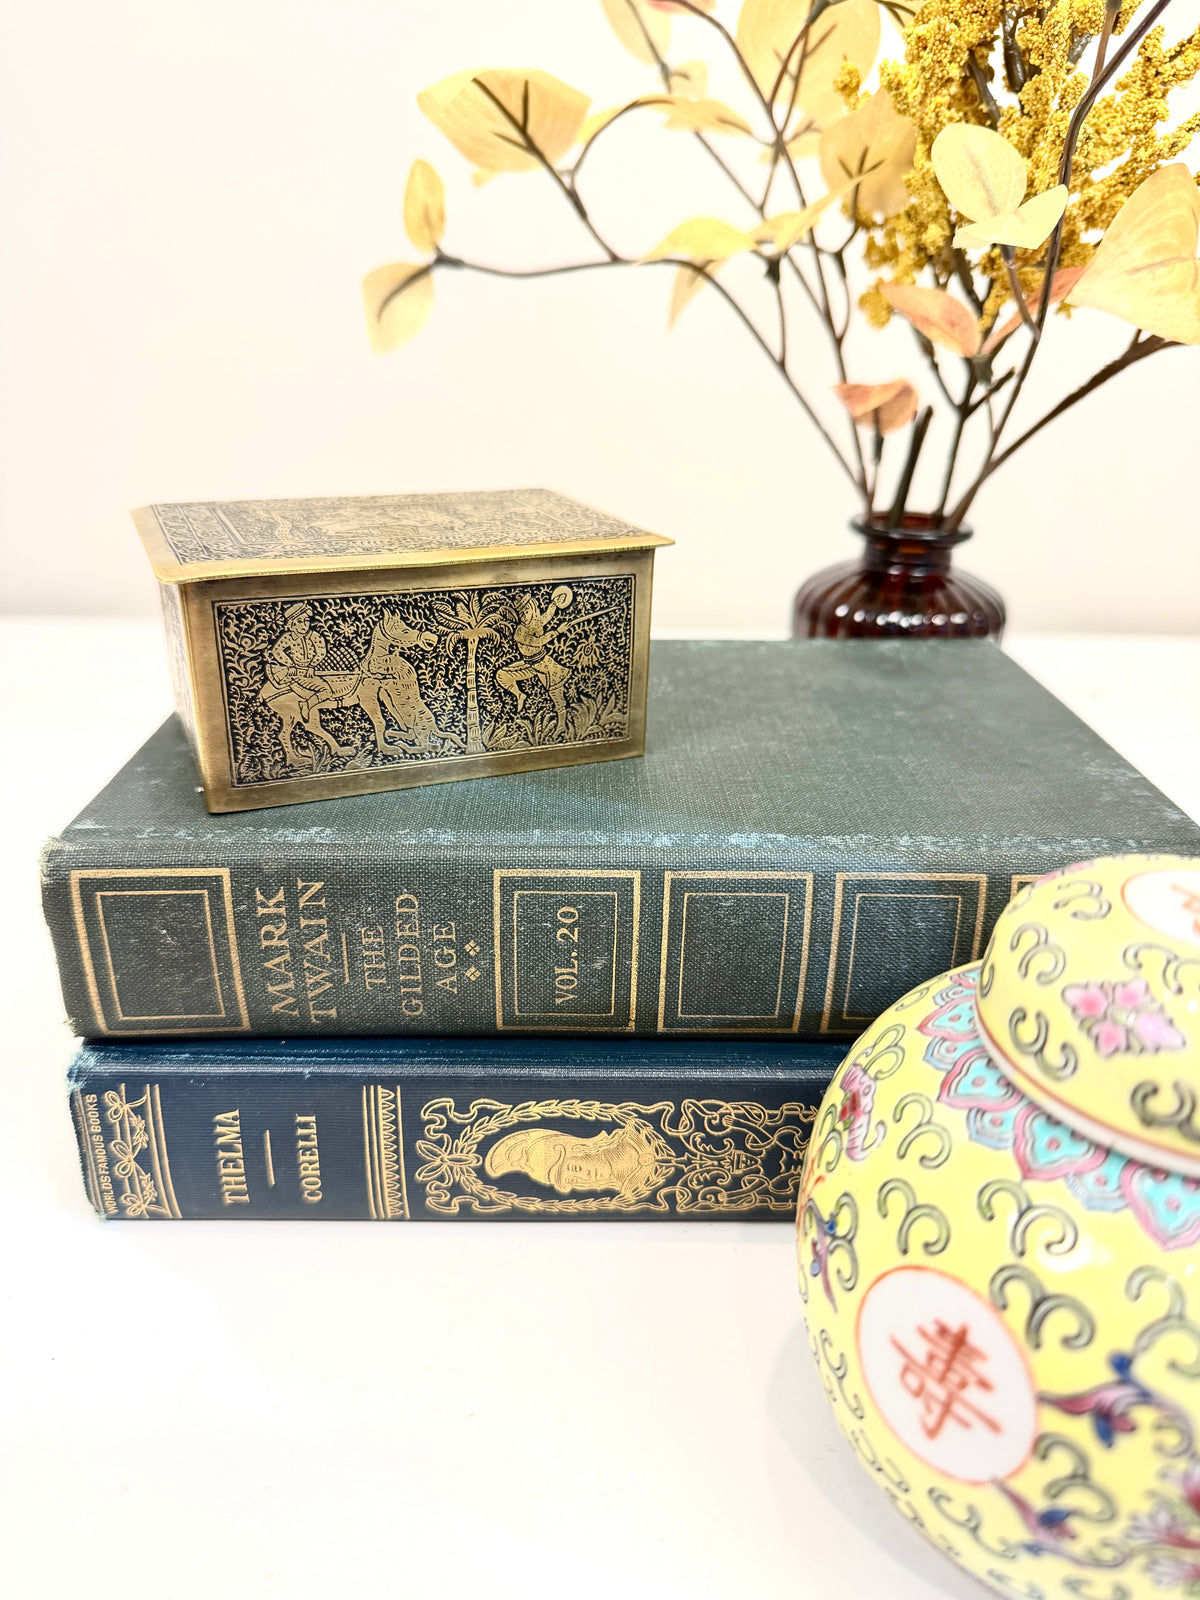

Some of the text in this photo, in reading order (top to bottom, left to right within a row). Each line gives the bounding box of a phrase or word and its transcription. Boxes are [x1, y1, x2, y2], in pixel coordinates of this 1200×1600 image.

[255, 886, 300, 1017] MARK
[297, 877, 338, 1024] TWAIN
[361, 925, 387, 990] THE
[396, 893, 424, 1016] GILDED
[433, 921, 458, 994] AGE
[554, 906, 579, 1005] VOL. 20
[85, 1093, 102, 1133] BOOKS
[93, 1134, 109, 1174] FAMOUS
[213, 1108, 250, 1206] THELMA
[295, 1113, 323, 1204] CORELLI
